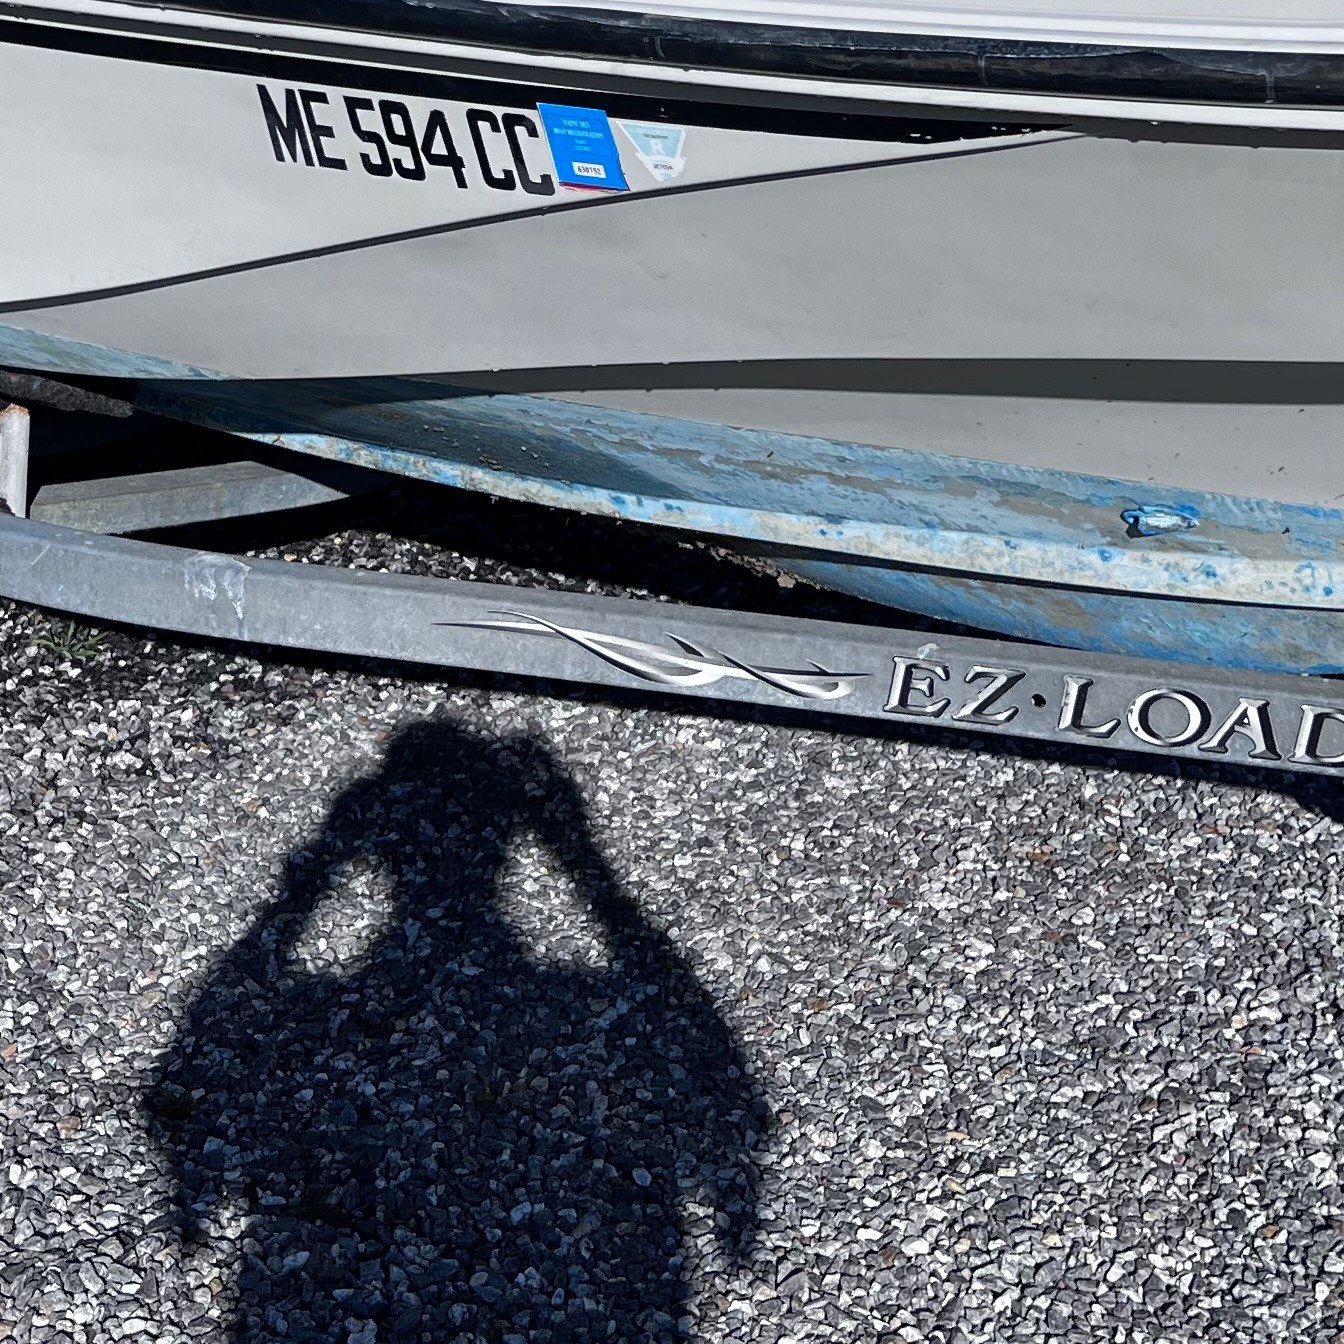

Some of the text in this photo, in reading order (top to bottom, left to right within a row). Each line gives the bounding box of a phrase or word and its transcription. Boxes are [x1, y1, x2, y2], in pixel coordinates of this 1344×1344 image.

[256, 84, 555, 196] ME 594 CC
